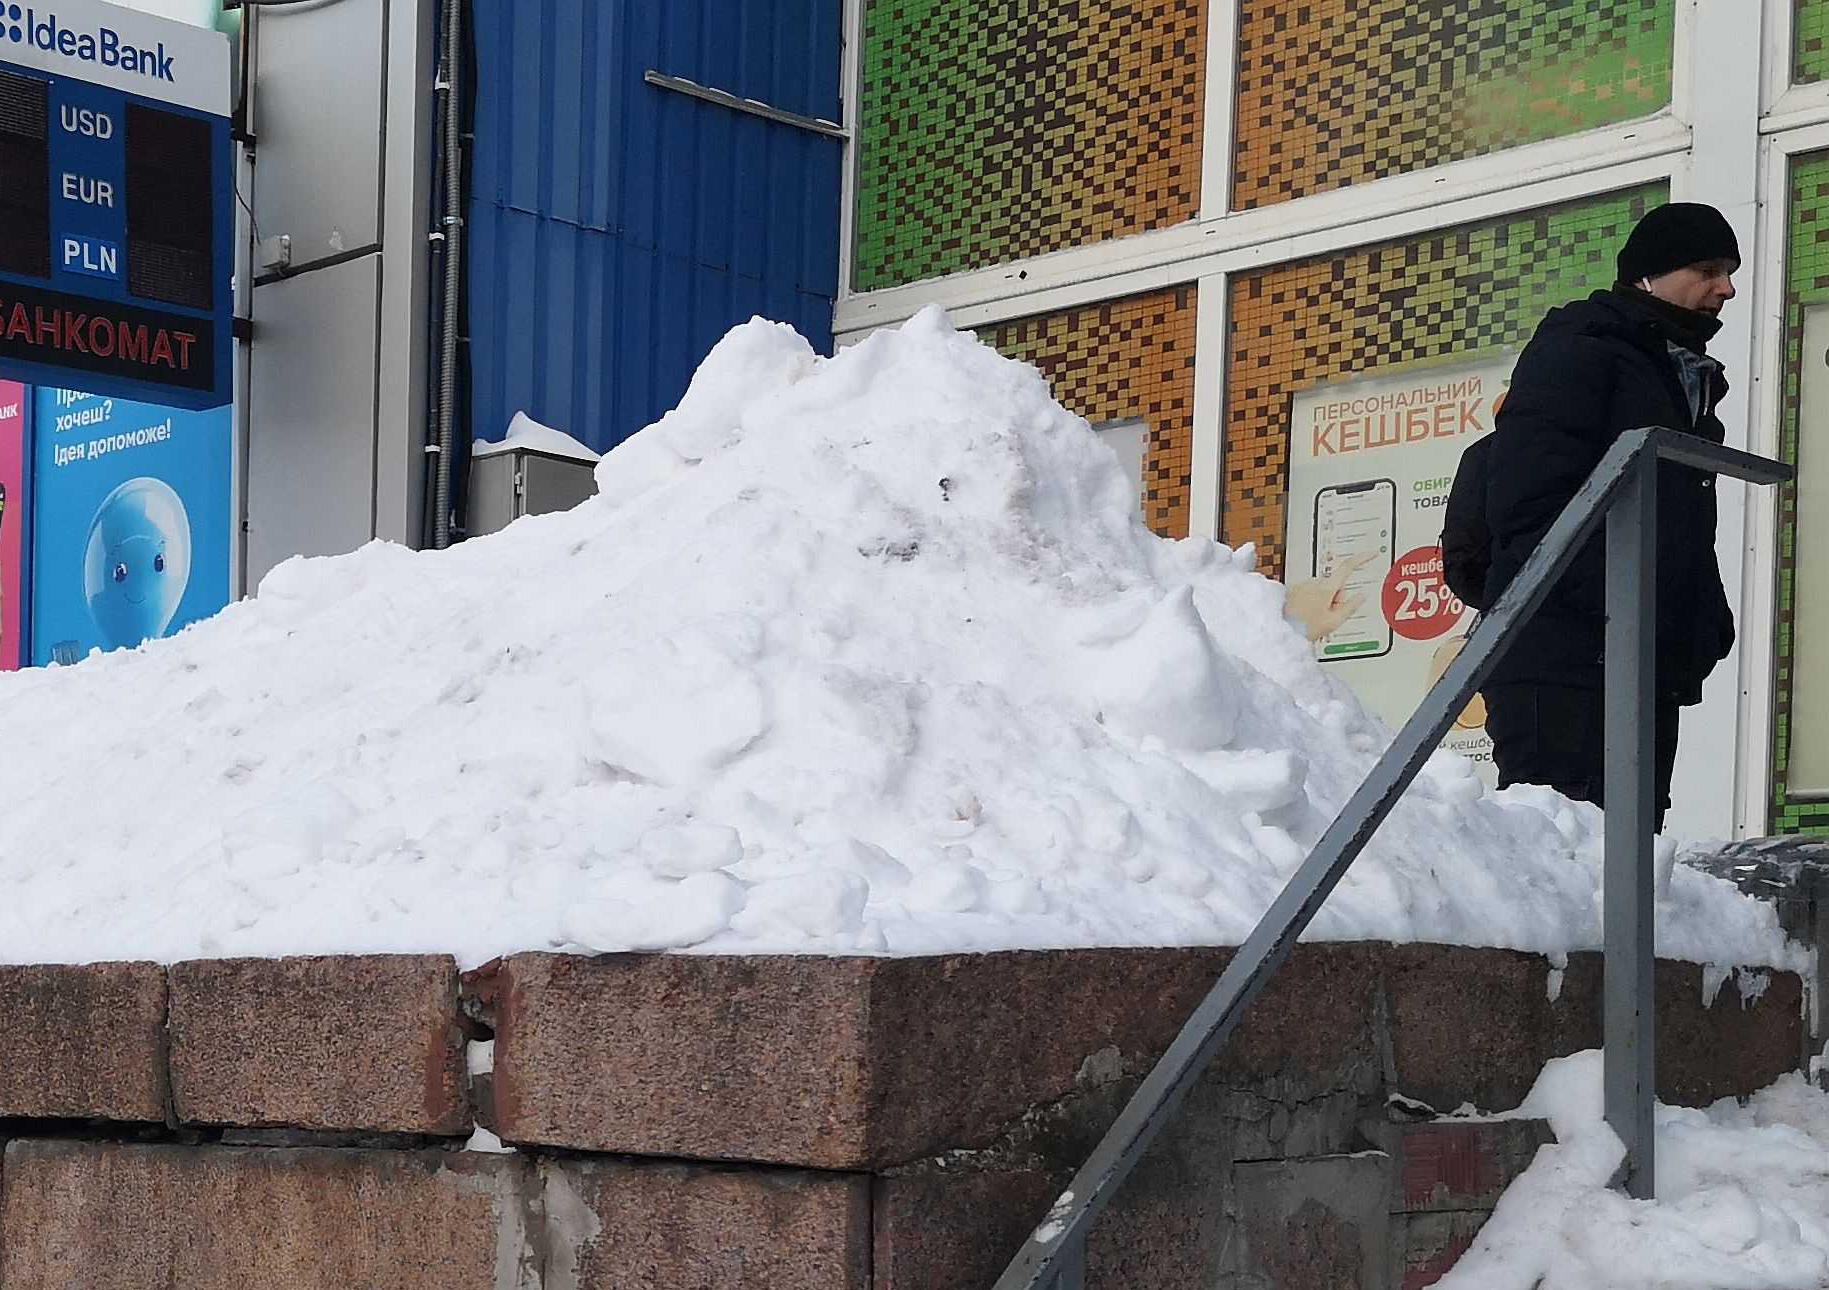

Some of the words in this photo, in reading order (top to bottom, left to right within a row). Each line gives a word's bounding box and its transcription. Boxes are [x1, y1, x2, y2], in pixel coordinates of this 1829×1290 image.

[61, 104, 113, 139] USD
[62, 172, 113, 208] EUR
[64, 239, 117, 274] PLN
[55, 400, 113, 433] хочеш?
[1314, 376, 1482, 422] ПЕРСОНАЛЬНИЙ
[55, 444, 85, 466] Ідея
[87, 418, 171, 460] допоможе!
[1313, 397, 1484, 457] КЕШБЕК
[1394, 578, 1463, 621] 25%
